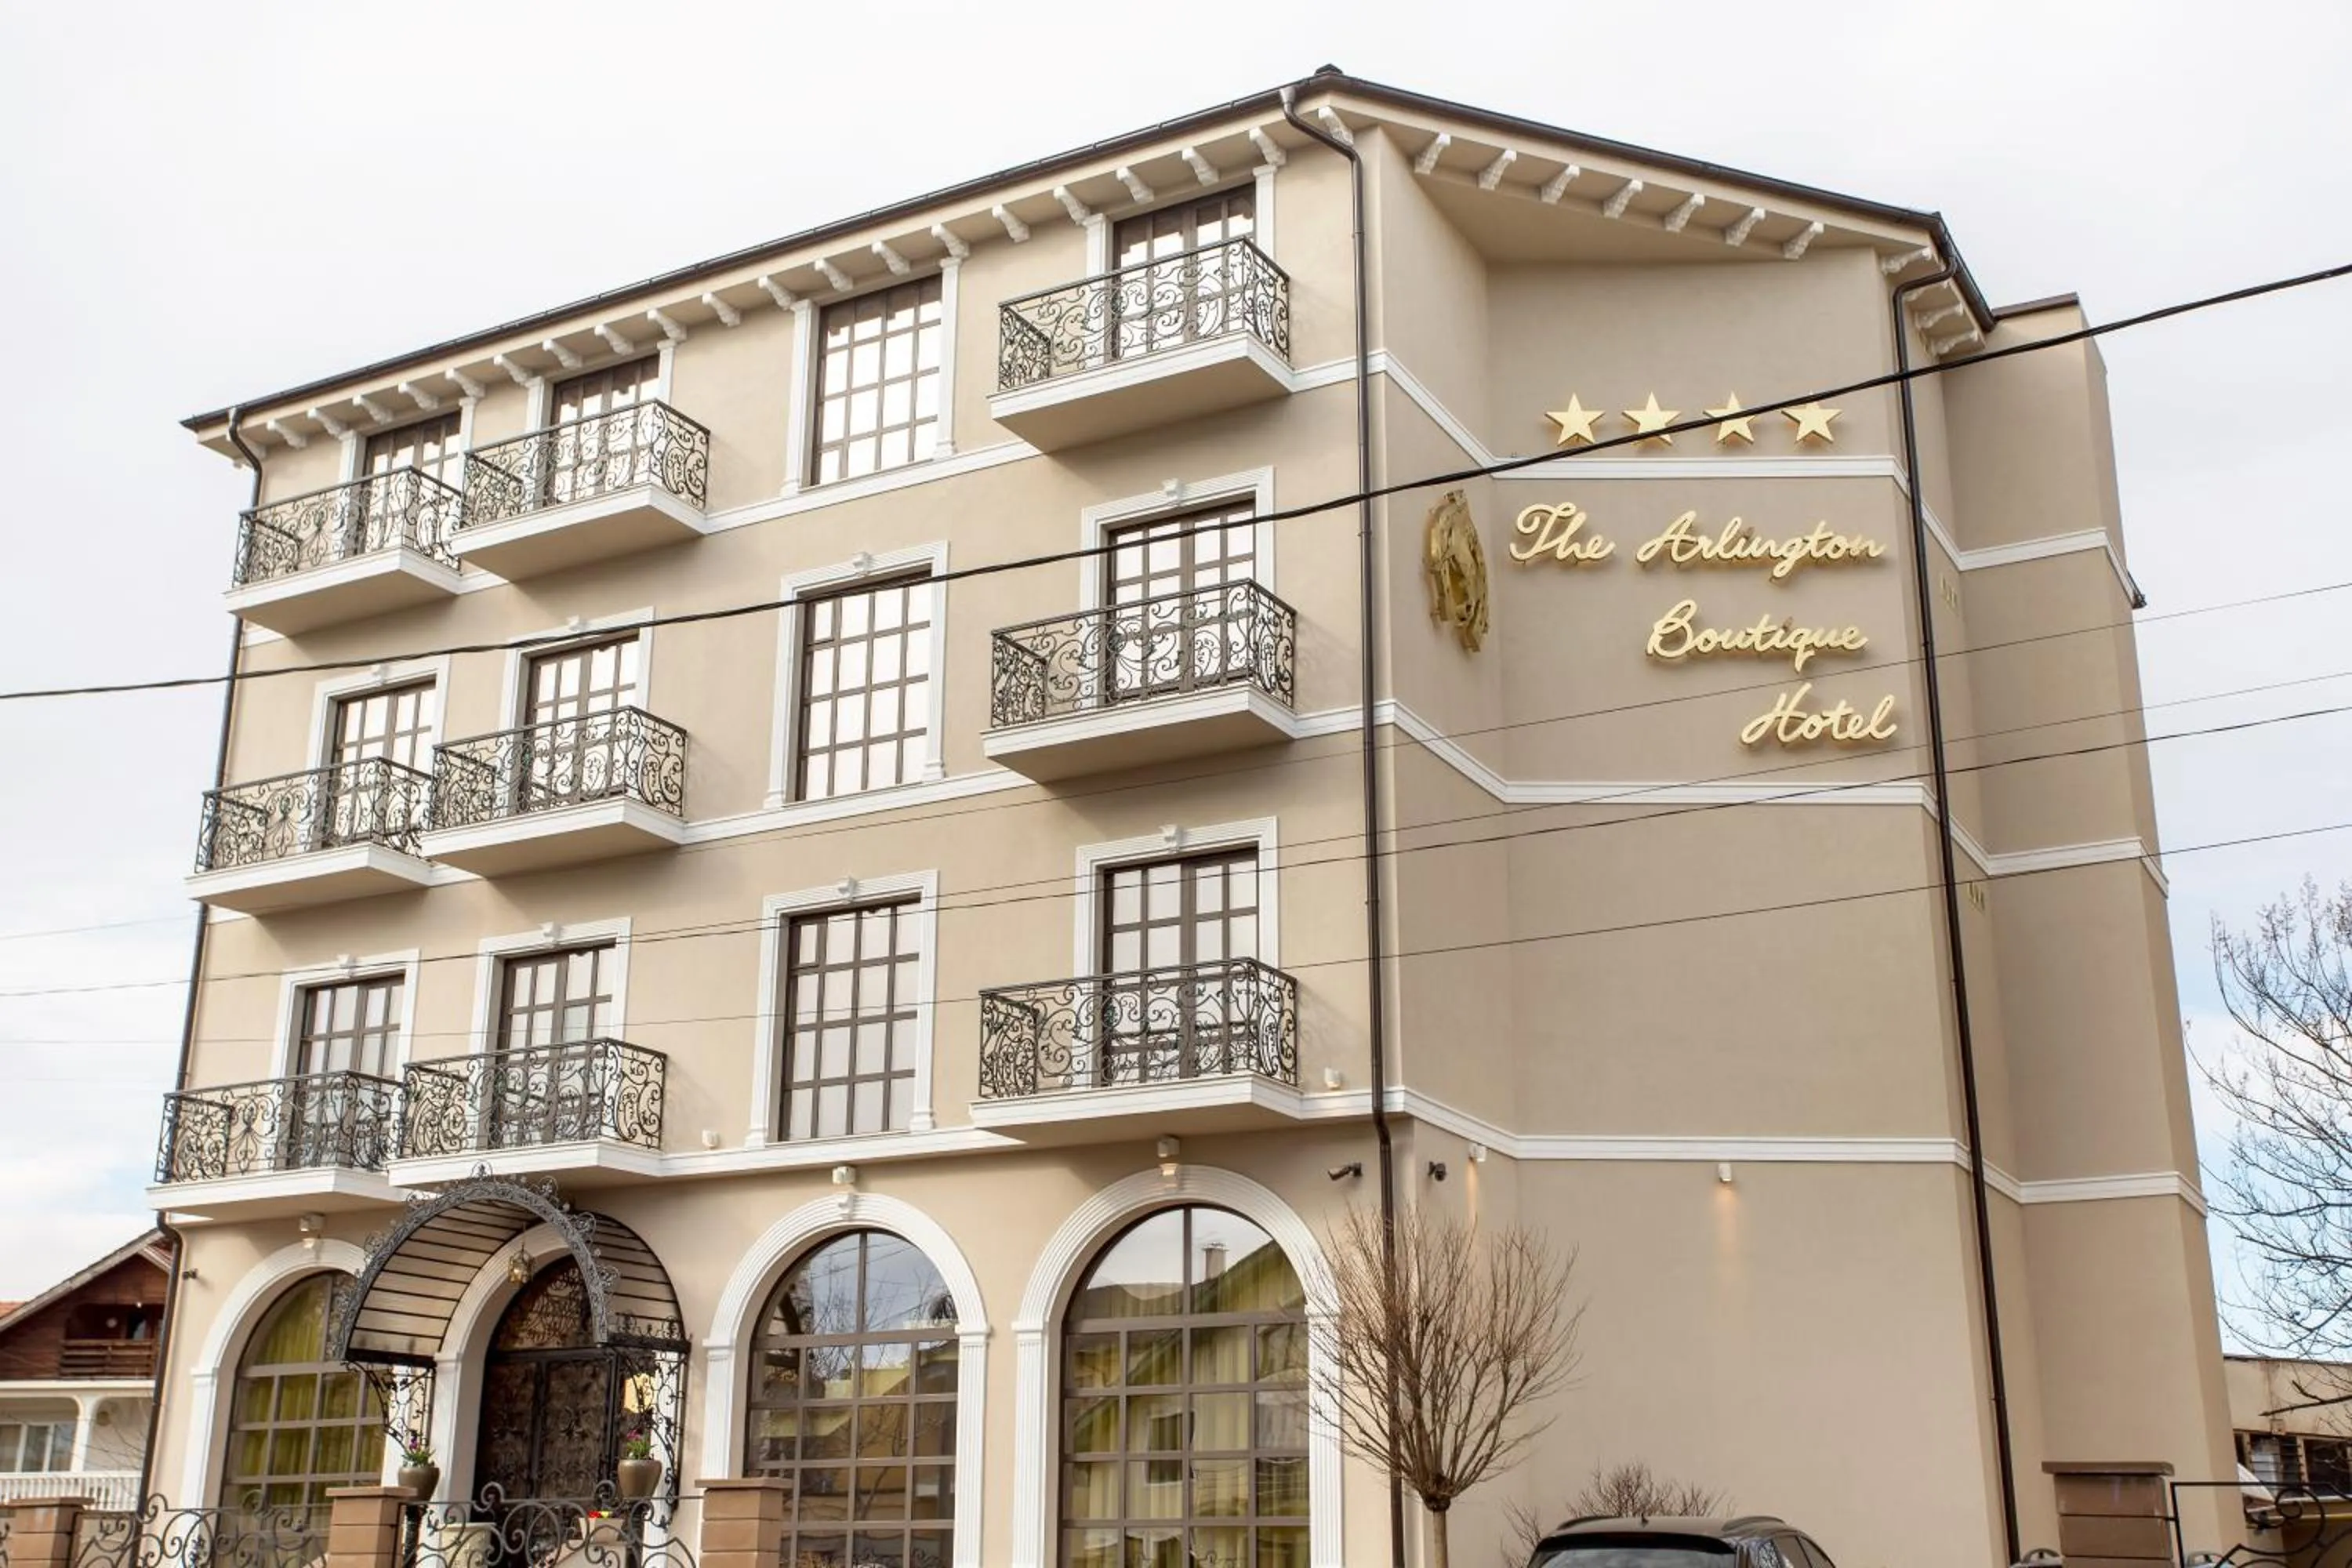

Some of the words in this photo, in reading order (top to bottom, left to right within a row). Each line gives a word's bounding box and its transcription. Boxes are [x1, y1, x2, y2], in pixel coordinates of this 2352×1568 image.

[1508, 502, 1616, 562] The
[1635, 510, 1886, 580] Arlington
[1646, 600, 1868, 672] Boutique
[1740, 682, 1897, 744] Hotel
